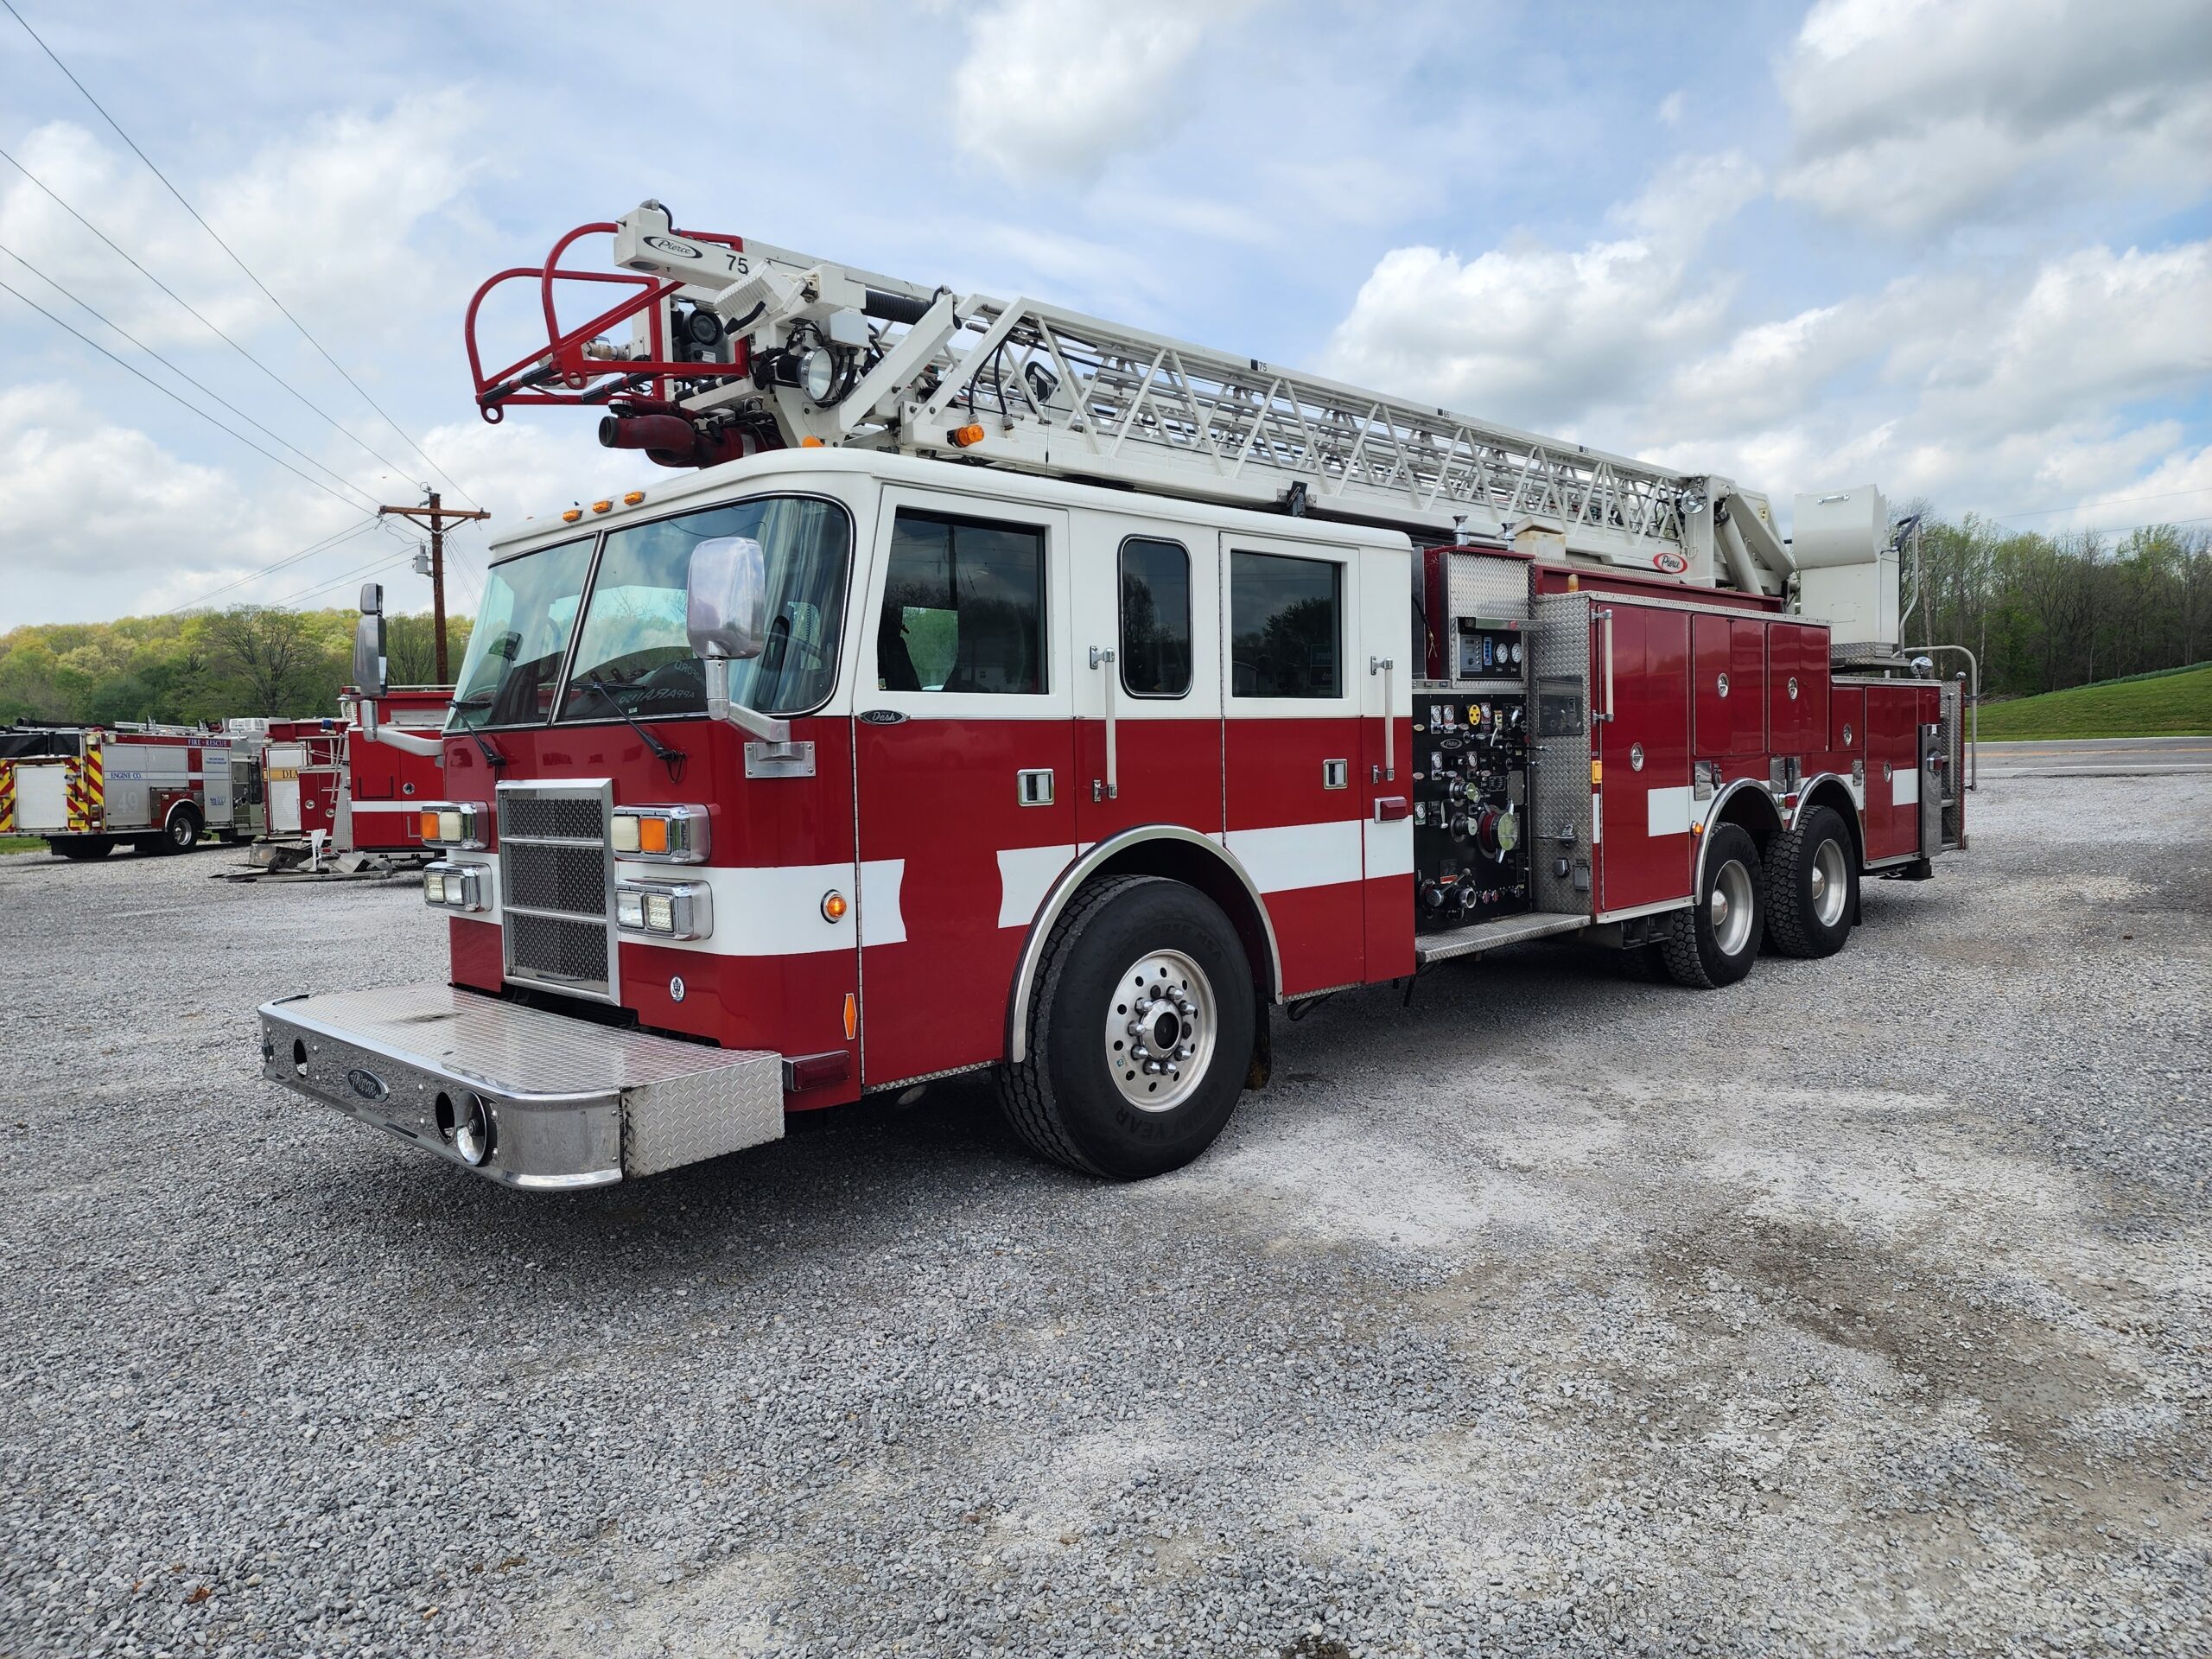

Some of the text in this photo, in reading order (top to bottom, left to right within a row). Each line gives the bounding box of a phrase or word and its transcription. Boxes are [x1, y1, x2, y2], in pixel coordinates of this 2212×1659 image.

[658, 239, 691, 255] Pierce
[727, 253, 749, 276] 75
[1258, 361, 1268, 372] 75
[1661, 555, 1681, 569] Pierce
[872, 711, 897, 721] Dash
